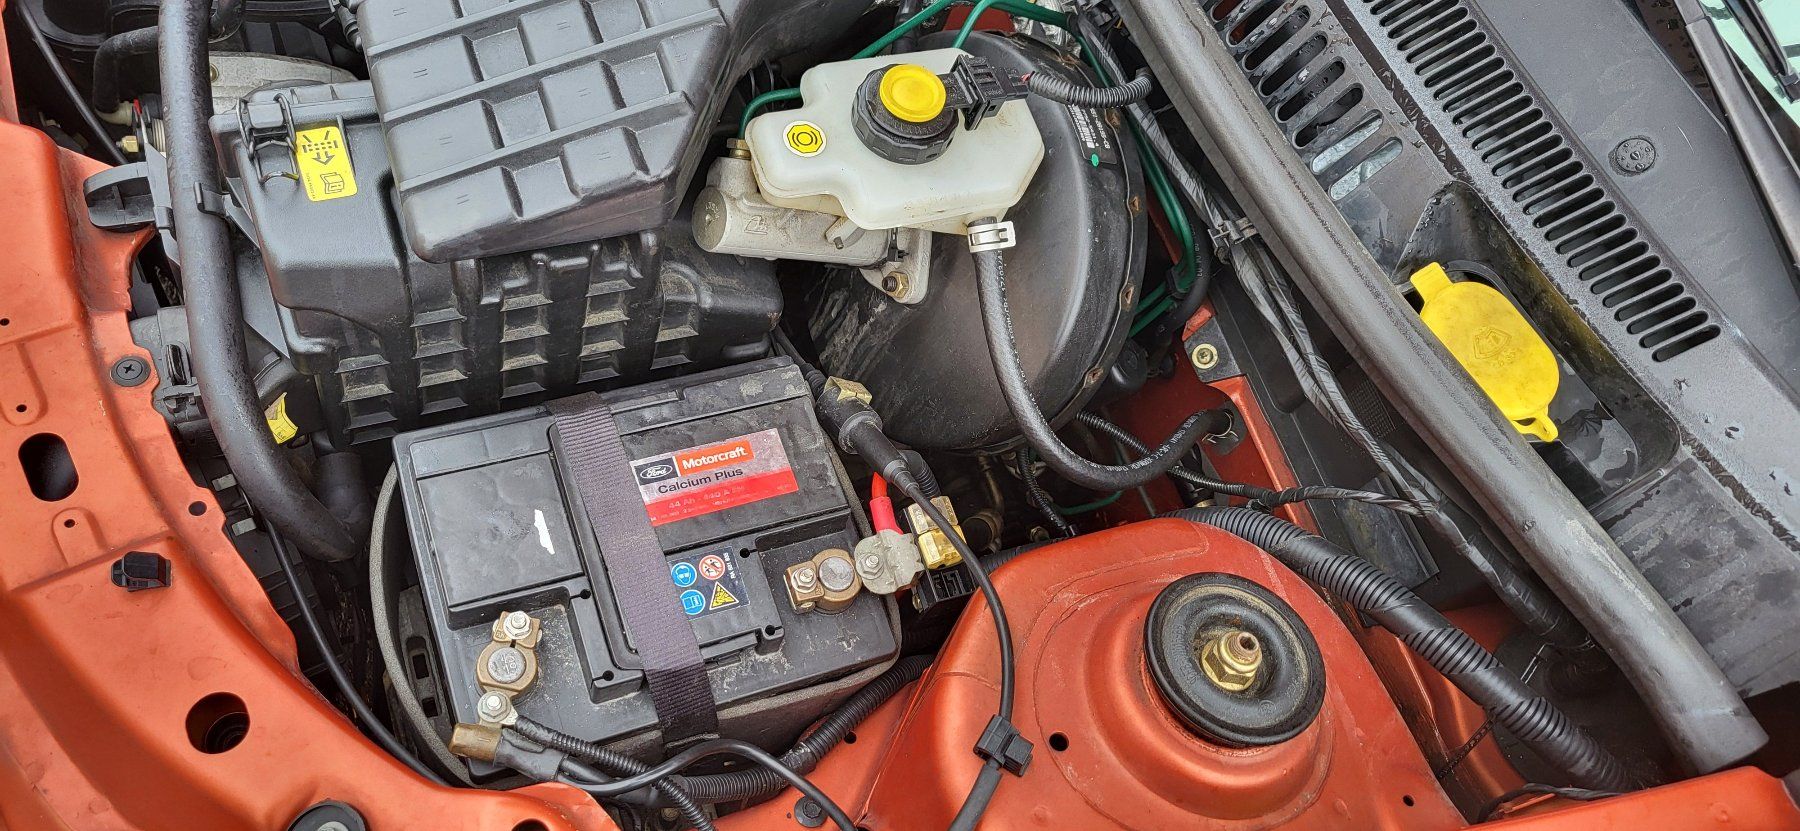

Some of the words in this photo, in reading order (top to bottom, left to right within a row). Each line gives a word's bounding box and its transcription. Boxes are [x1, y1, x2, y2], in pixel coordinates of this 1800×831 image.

[682, 446, 748, 470] Motorcraft
[645, 465, 669, 478] Ford
[658, 475, 712, 494] Calcium
[714, 467, 744, 481] Plus
